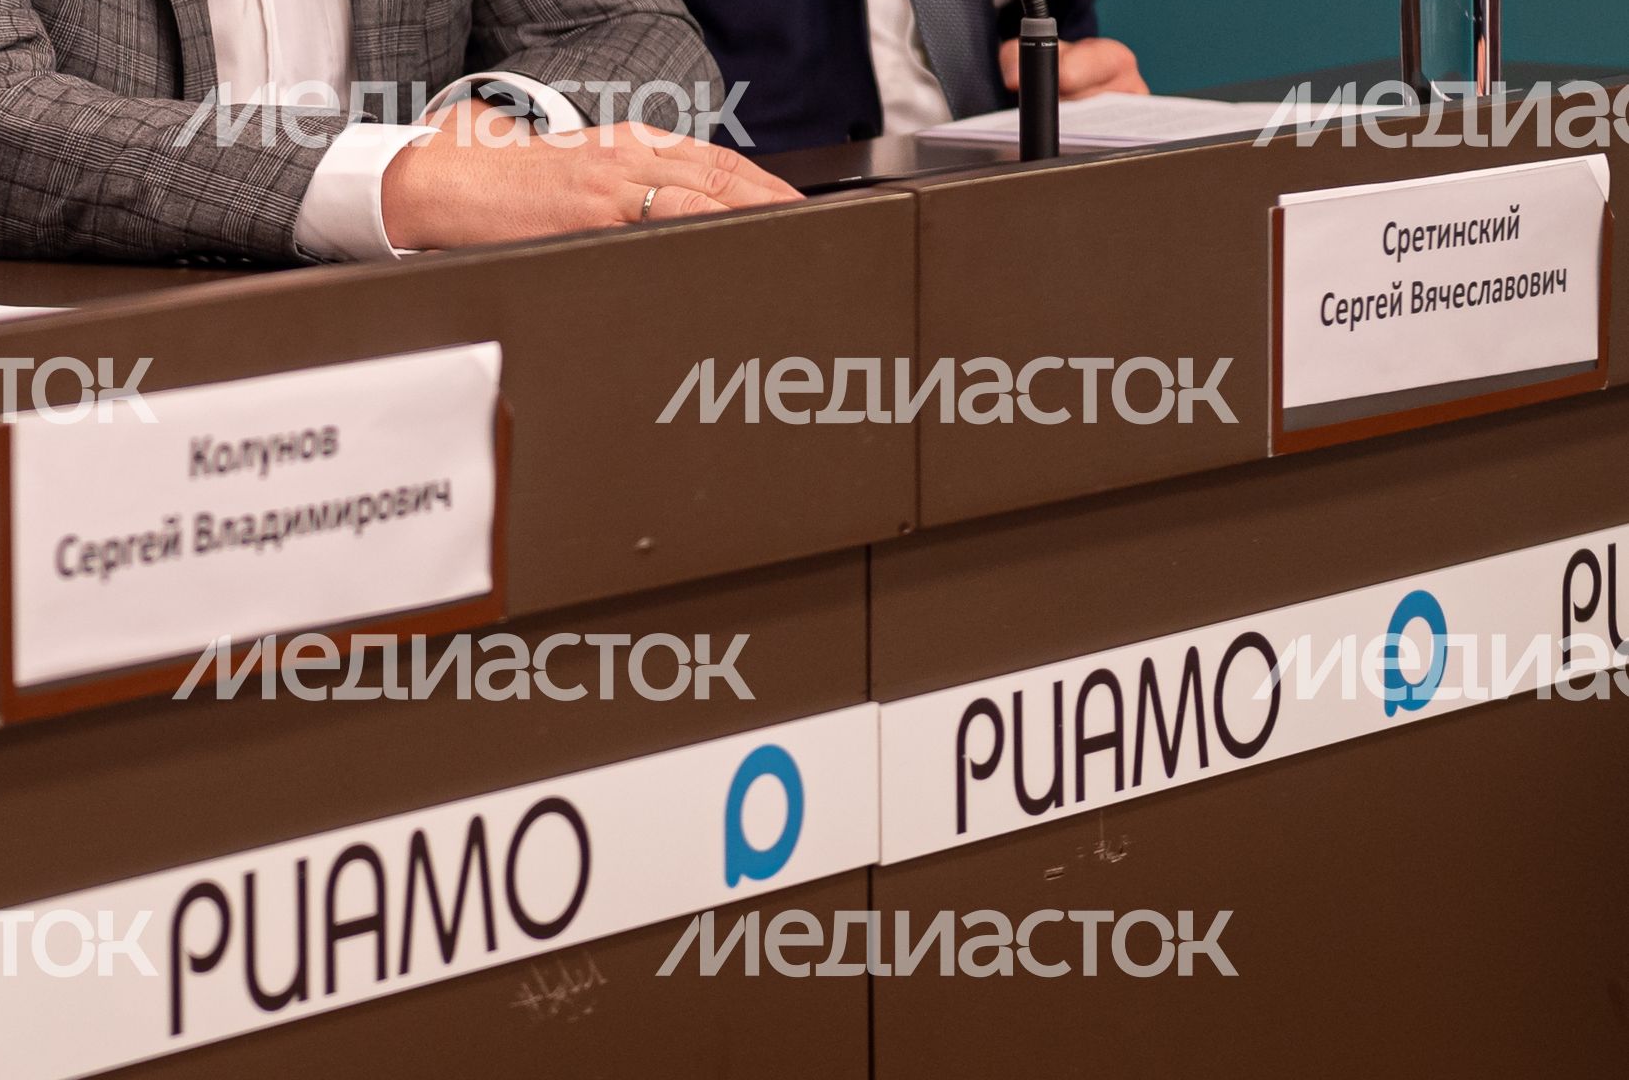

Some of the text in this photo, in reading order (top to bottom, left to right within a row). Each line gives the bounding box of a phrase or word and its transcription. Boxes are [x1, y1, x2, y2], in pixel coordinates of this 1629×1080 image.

[1382, 204, 1521, 264] Сретинский
[1320, 268, 1568, 333] Сергей Вячеславович
[188, 425, 340, 478] Колунов
[54, 478, 453, 582] Сергей Владимирович
[169, 796, 591, 1037] РИАМО
